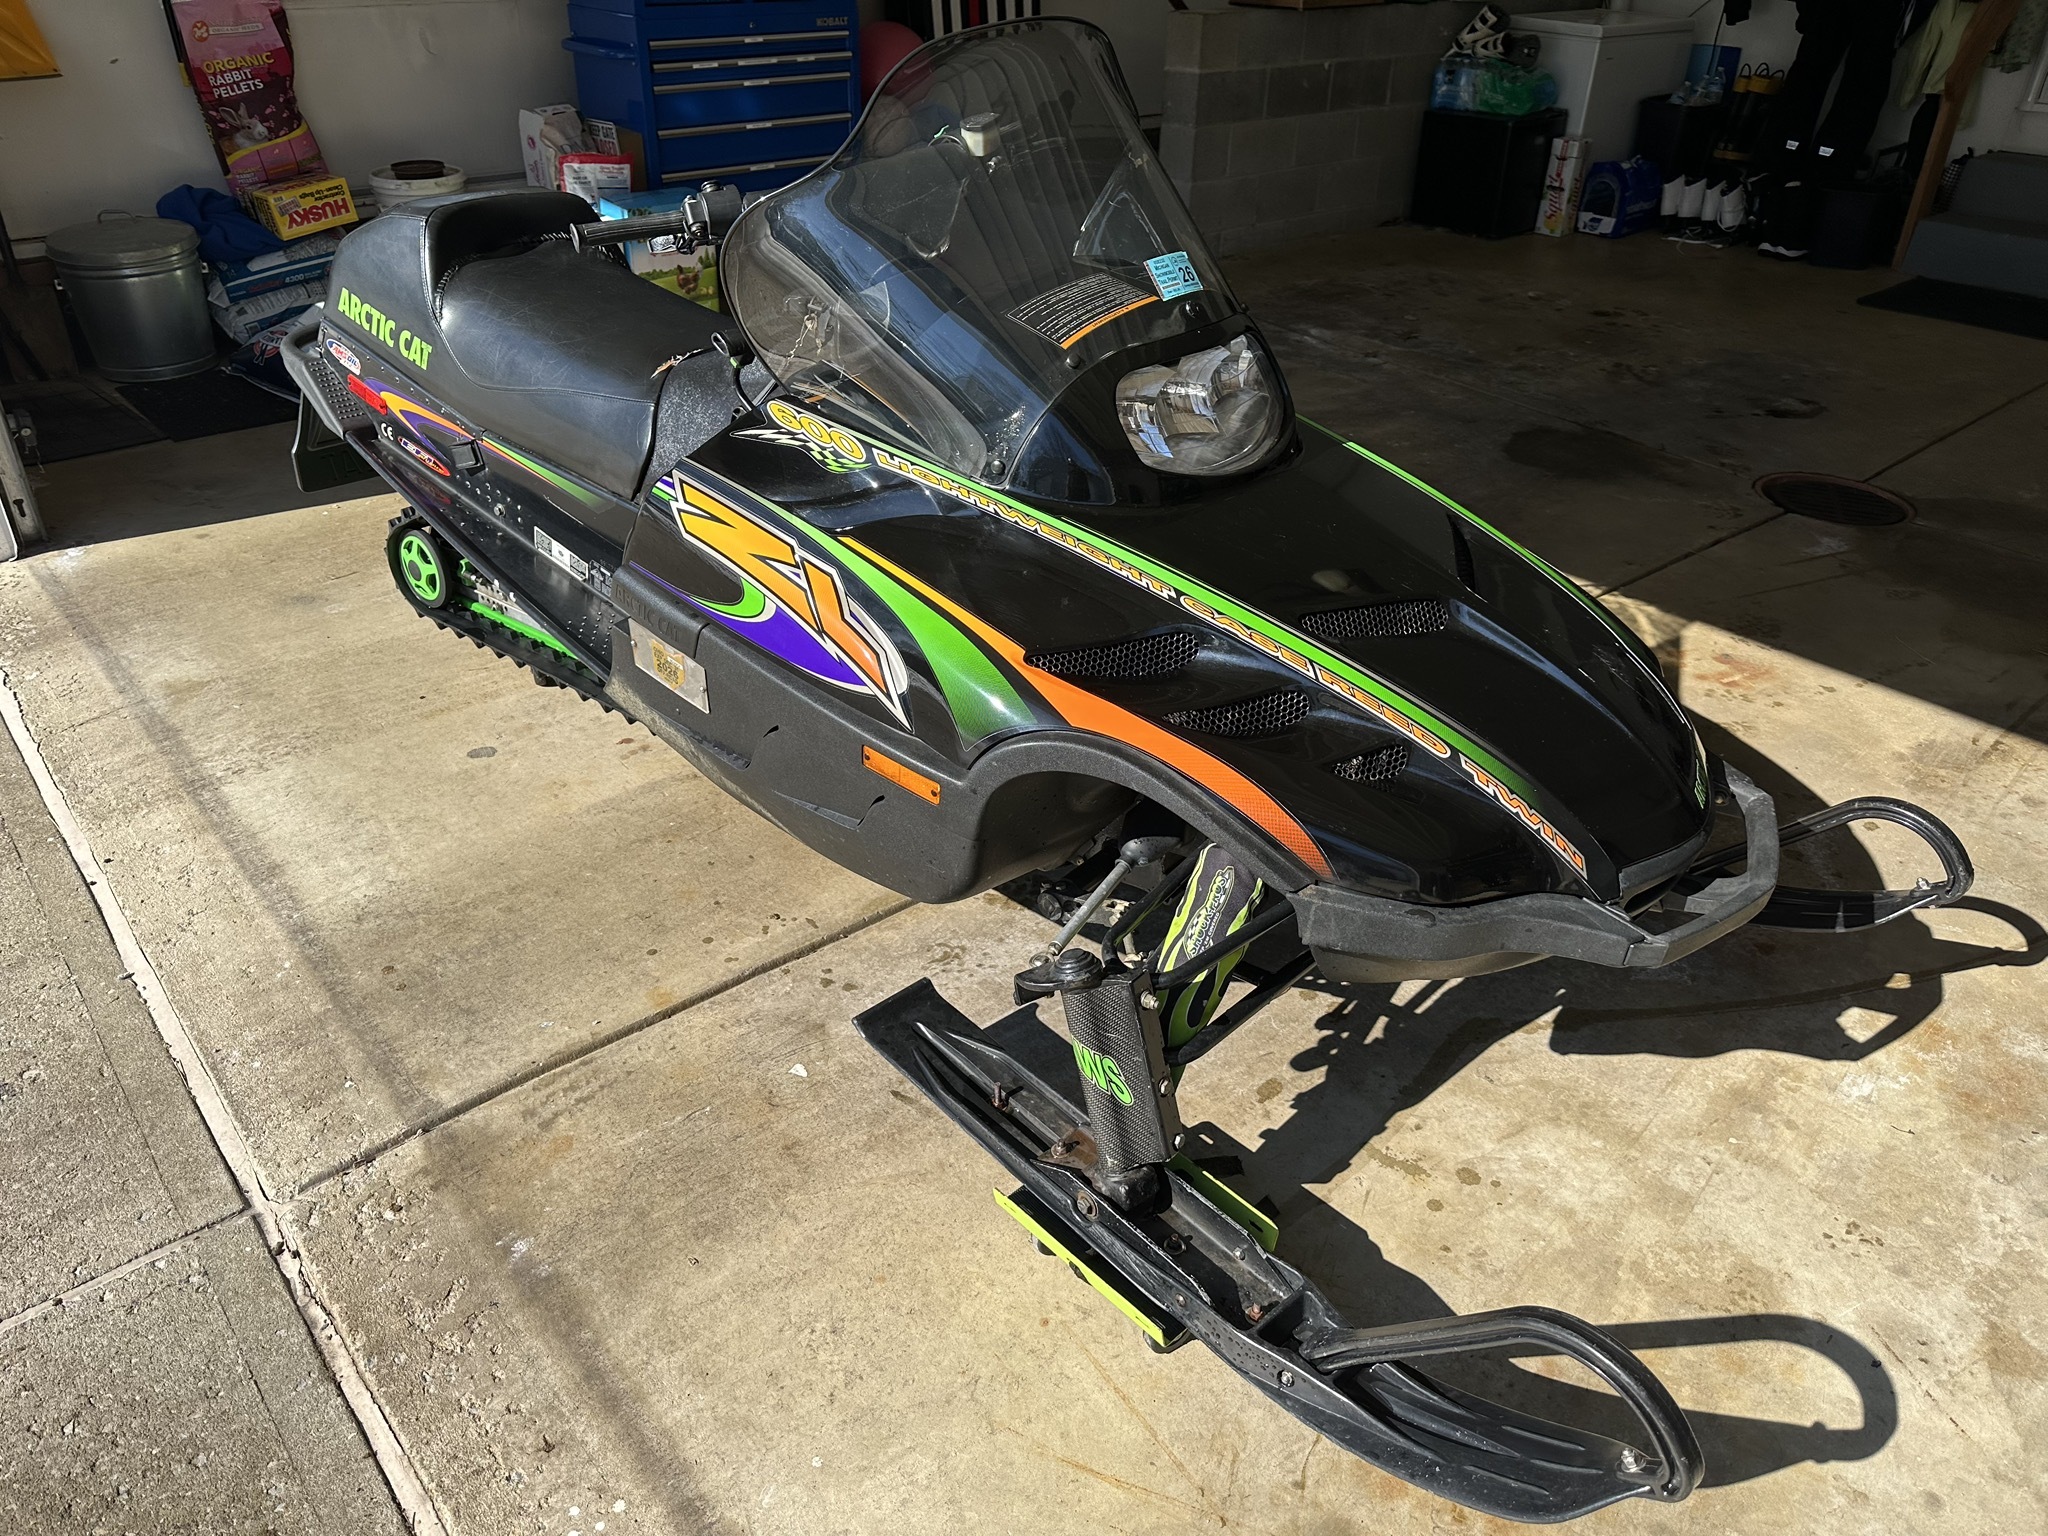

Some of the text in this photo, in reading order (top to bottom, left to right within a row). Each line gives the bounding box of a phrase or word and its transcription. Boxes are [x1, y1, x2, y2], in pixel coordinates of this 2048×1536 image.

[816, 17, 848, 27] KOBALT
[202, 52, 274, 74] ORGANIC
[208, 69, 253, 87] RABBIT
[212, 79, 264, 99] PELLETS
[287, 198, 351, 230] HUSKY
[1178, 266, 1195, 282] 26
[338, 287, 396, 348] ARCTIC
[399, 329, 433, 371] CAT
[767, 401, 866, 462] 600
[615, 583, 678, 642] ARCTIC CAT
[872, 447, 1177, 600] LIGHTWEIGHT
[1180, 595, 1316, 680] CASE
[1312, 662, 1451, 758] REED
[1459, 752, 1587, 880] TWIN
